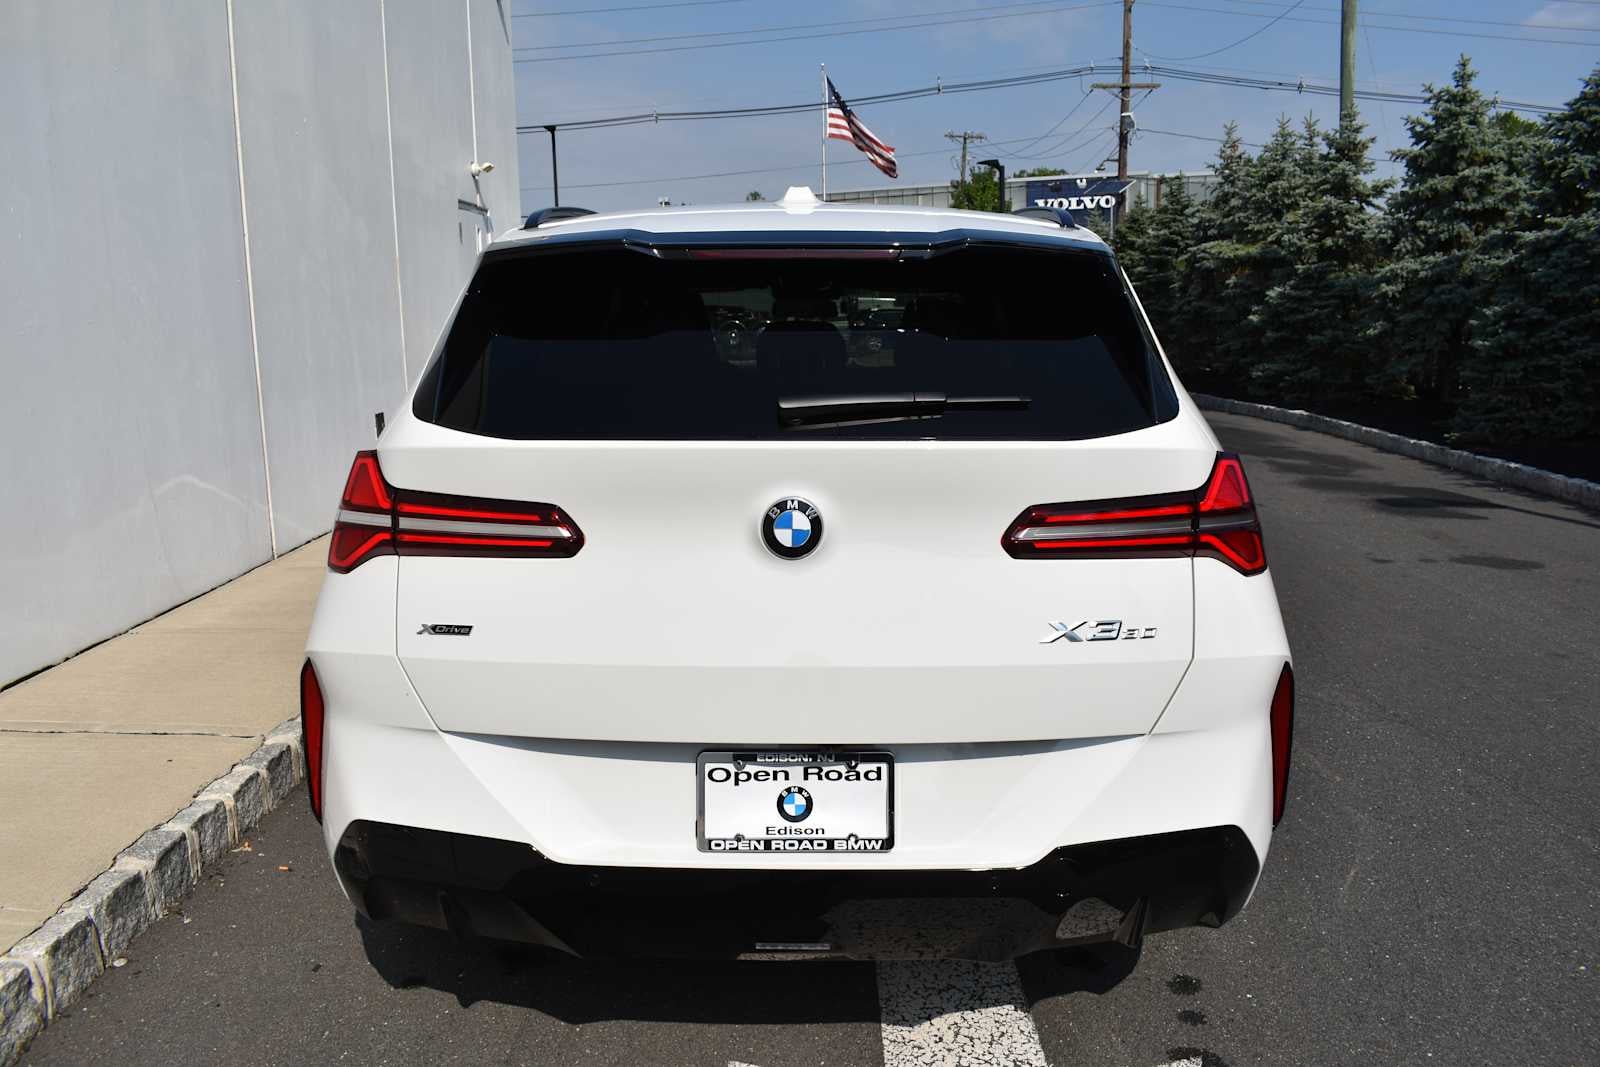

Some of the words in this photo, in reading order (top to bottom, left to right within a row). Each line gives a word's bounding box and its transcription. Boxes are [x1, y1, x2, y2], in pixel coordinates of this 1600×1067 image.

[1034, 195, 1116, 210] VOLVO
[768, 499, 818, 520] BMW
[817, 753, 835, 762] NJ
[707, 767, 790, 786] Open
[803, 766, 882, 781] Road
[781, 786, 810, 797] BMW
[765, 826, 825, 836] Edison
[710, 839, 764, 850] OPEN
[771, 839, 828, 850] ROAD
[833, 839, 883, 850] BMW
